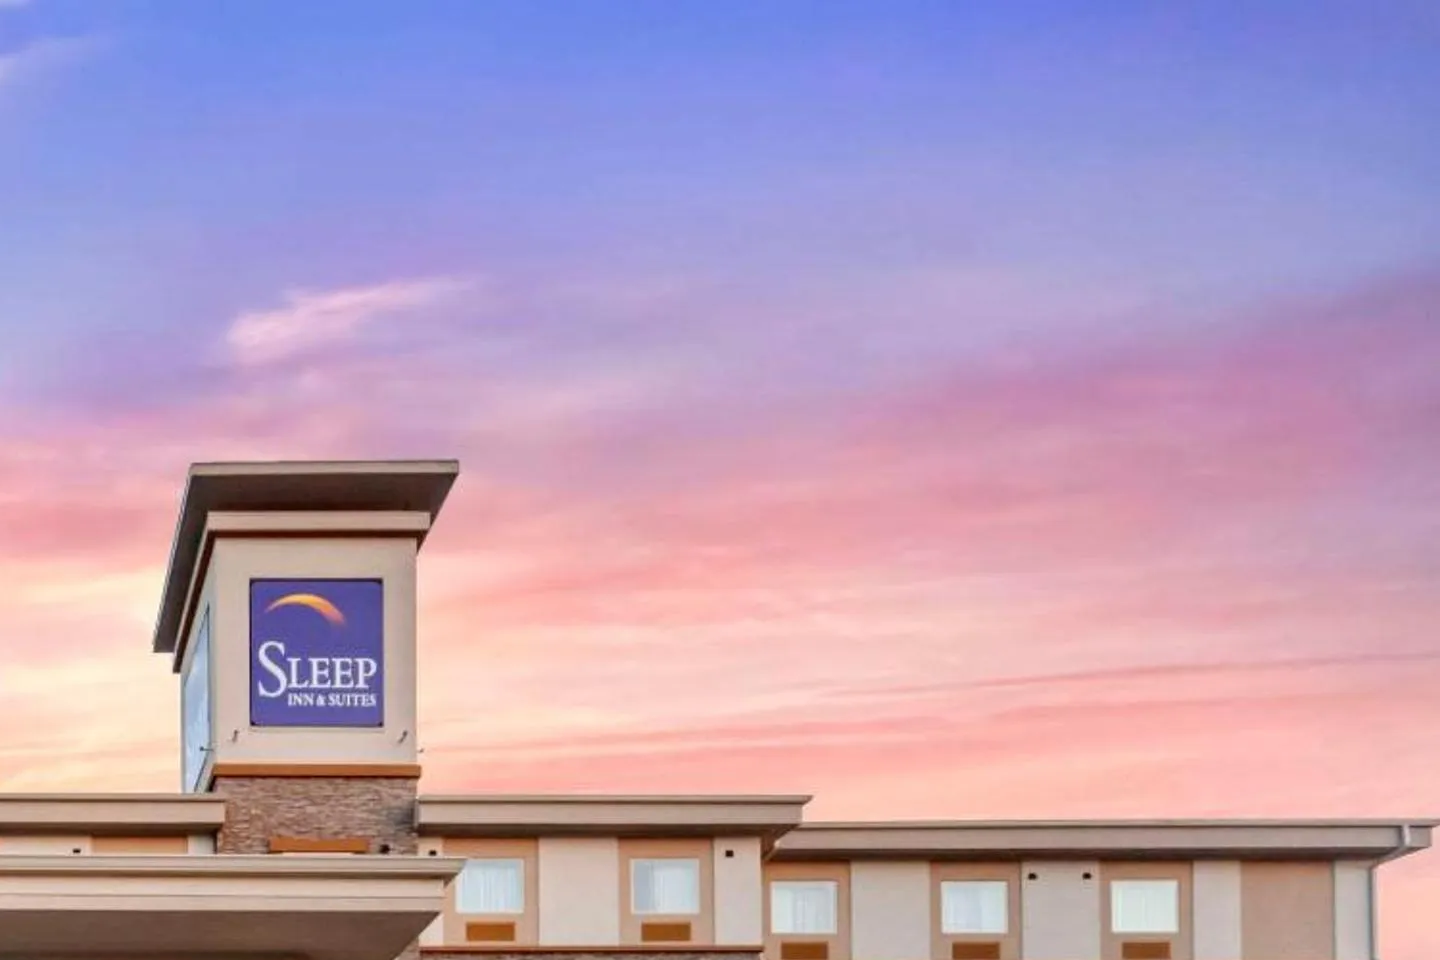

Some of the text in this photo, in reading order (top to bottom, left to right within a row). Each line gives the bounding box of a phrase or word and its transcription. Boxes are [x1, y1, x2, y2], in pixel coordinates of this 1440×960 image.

[258, 640, 378, 698] SLEEP
[287, 692, 377, 707] INN & SUITES
